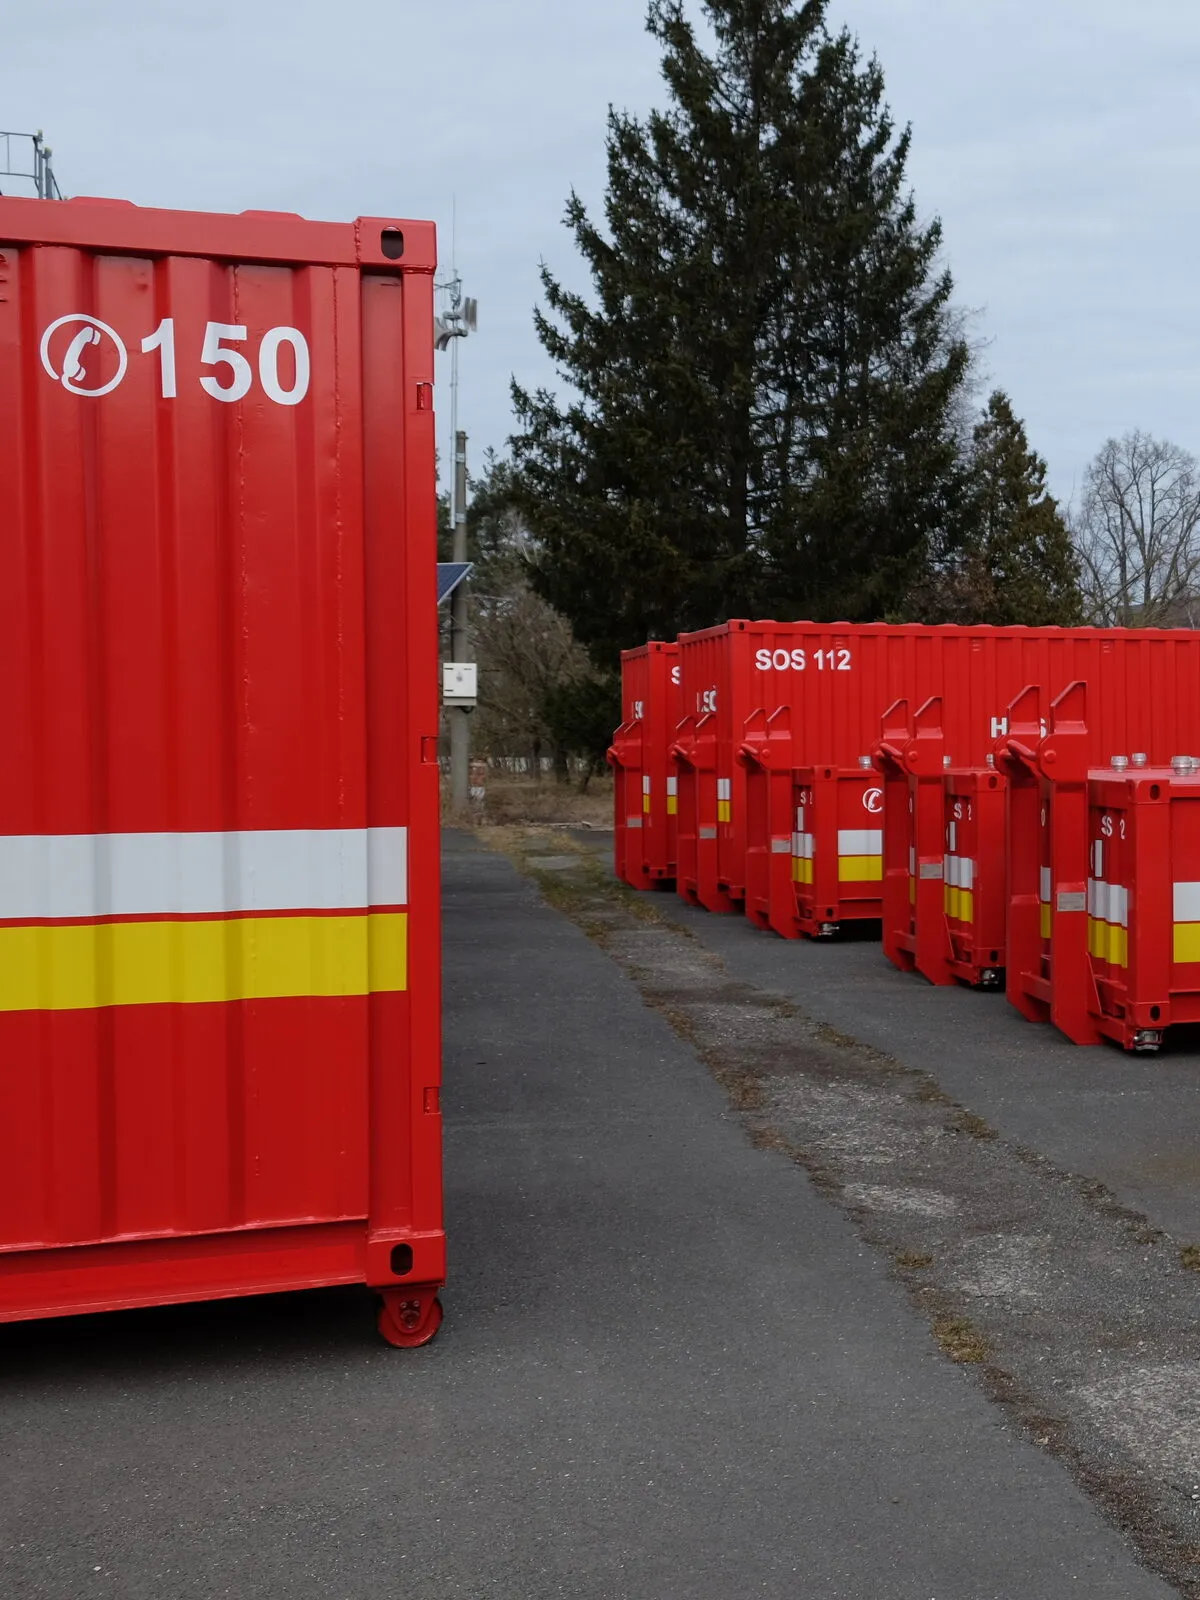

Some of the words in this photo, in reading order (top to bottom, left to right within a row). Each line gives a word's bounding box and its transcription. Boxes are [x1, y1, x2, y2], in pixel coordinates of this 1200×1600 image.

[140, 318, 311, 406] 150
[755, 649, 806, 671] SOS
[813, 649, 851, 671] 112
